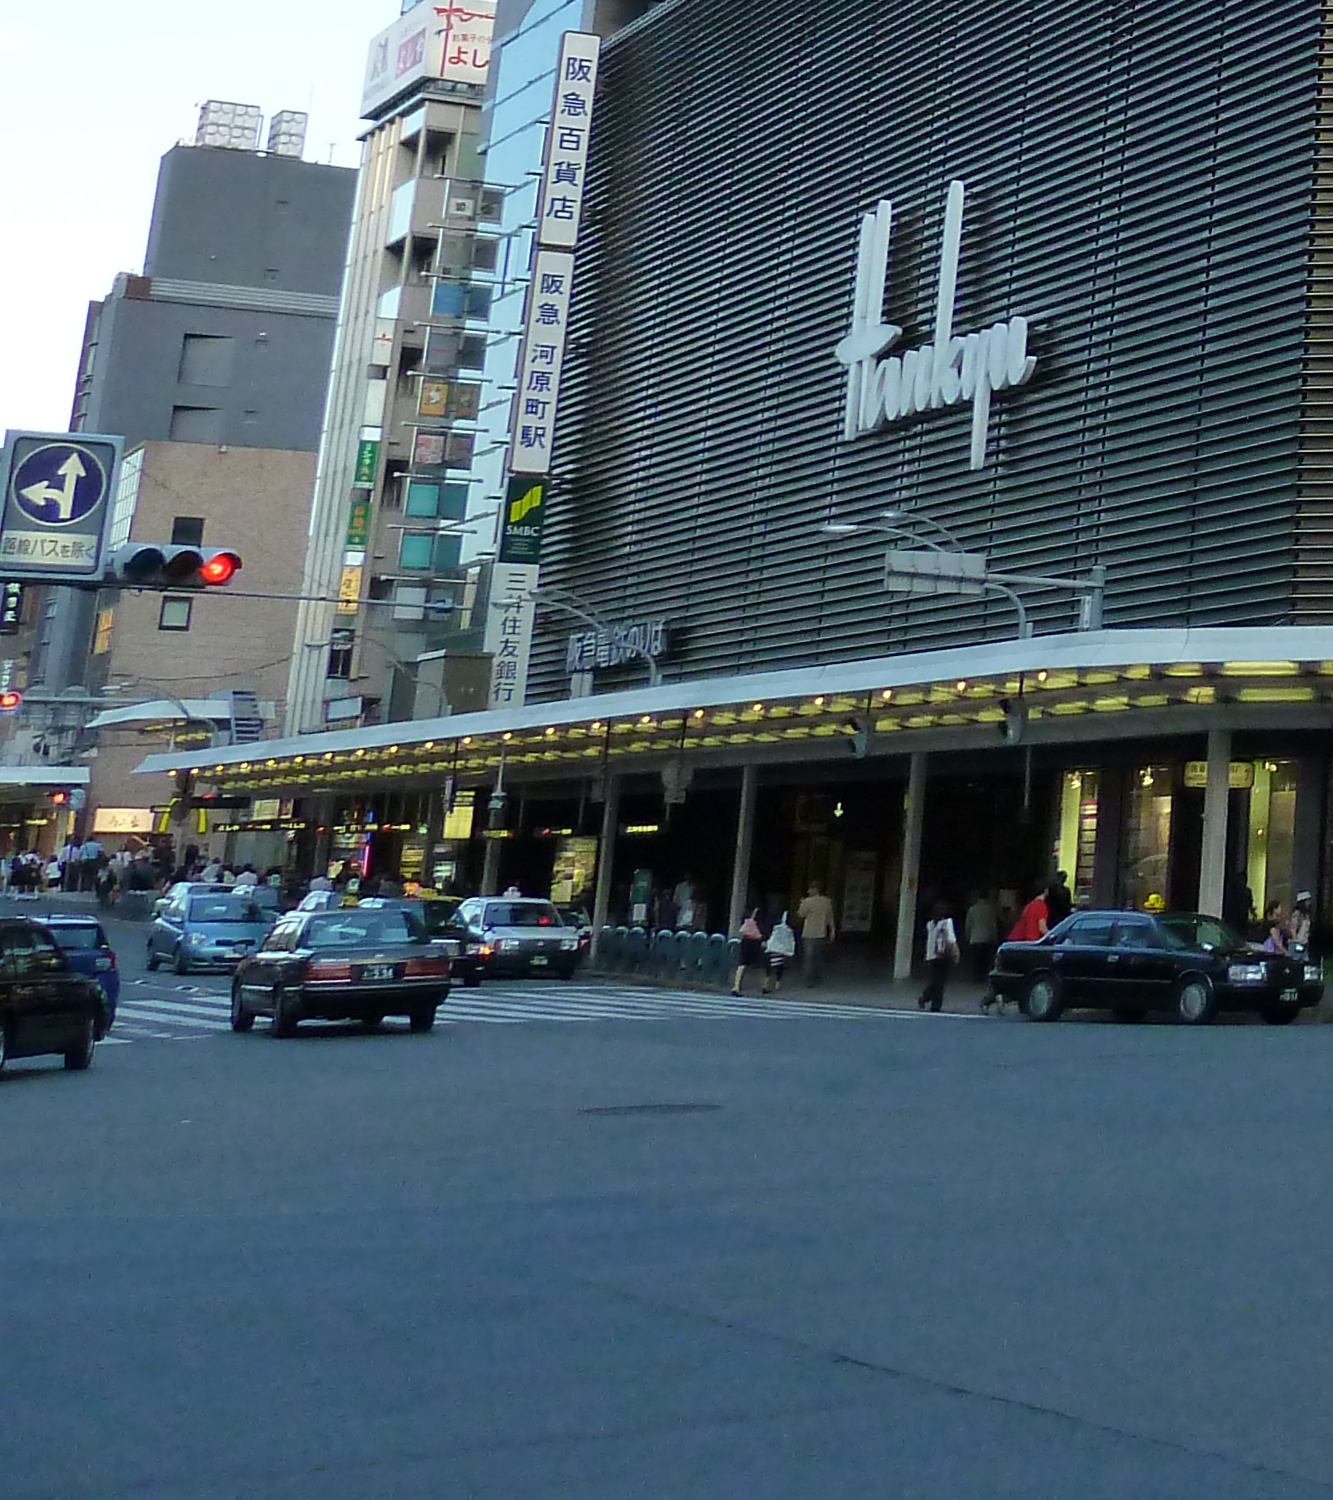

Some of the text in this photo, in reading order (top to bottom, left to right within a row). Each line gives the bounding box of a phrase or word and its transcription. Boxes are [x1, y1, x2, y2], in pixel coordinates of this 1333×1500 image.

[546, 56, 592, 221] 阪急百貨店
[835, 179, 1038, 471] Hankyu
[4, 535, 96, 559] 路線バスを除く
[505, 525, 540, 537] SMBC
[493, 573, 527, 701] 三井住友銀行
